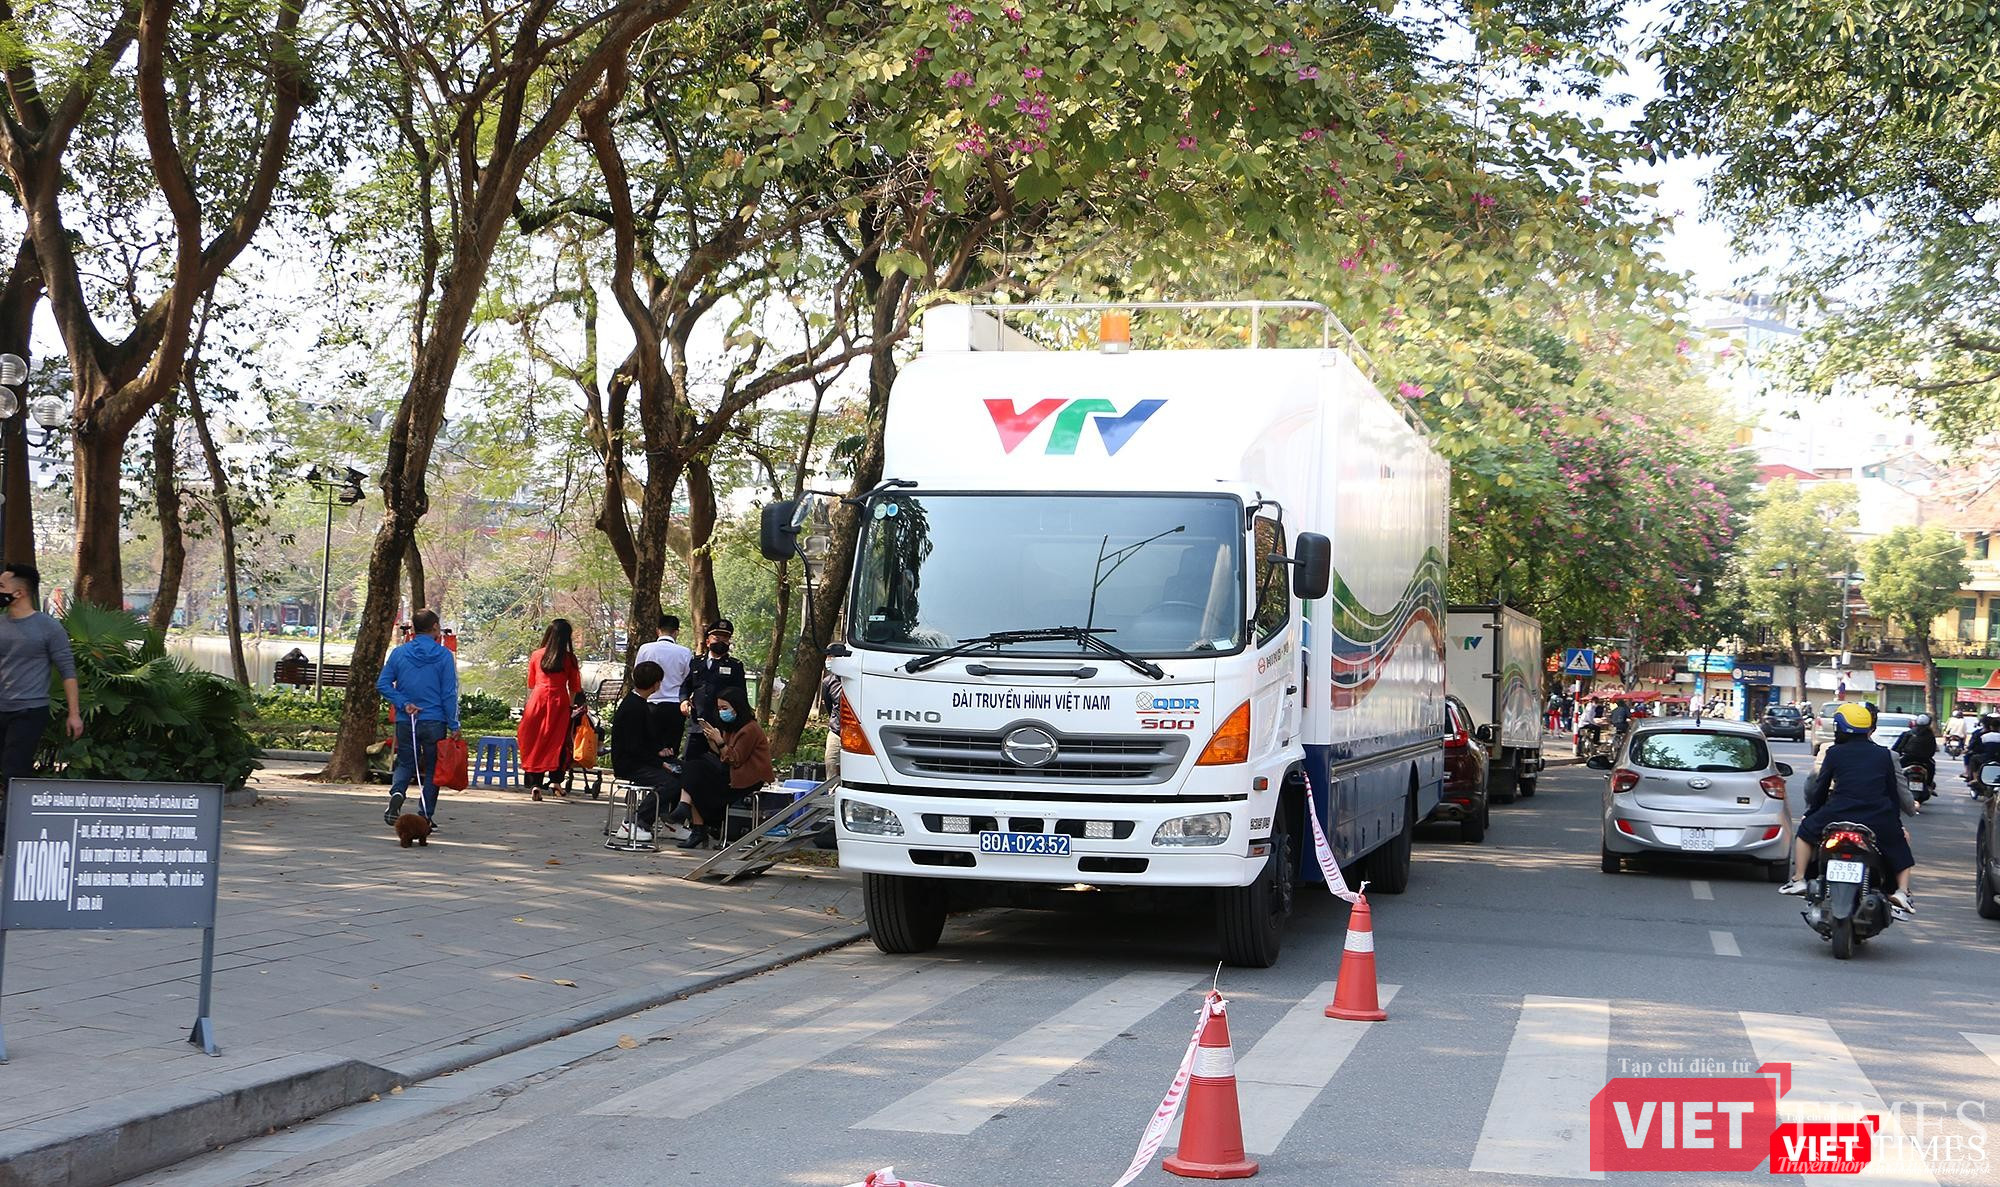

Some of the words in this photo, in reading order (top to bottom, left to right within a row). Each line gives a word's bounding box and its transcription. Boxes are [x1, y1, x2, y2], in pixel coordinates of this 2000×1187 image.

[982, 398, 1169, 457] VTV
[1450, 636, 1483, 650] VTV
[952, 689, 972, 708] ĐÀI
[975, 688, 1021, 709] TRUYỀN
[1023, 690, 1051, 709] HÌNH
[1054, 691, 1080, 712] VIỆT
[1082, 695, 1111, 710] NAM
[876, 709, 942, 723] HINO
[1141, 719, 1195, 730] 500
[981, 832, 1069, 855] 80A-023.52
[13, 828, 70, 901] KHÔNG
